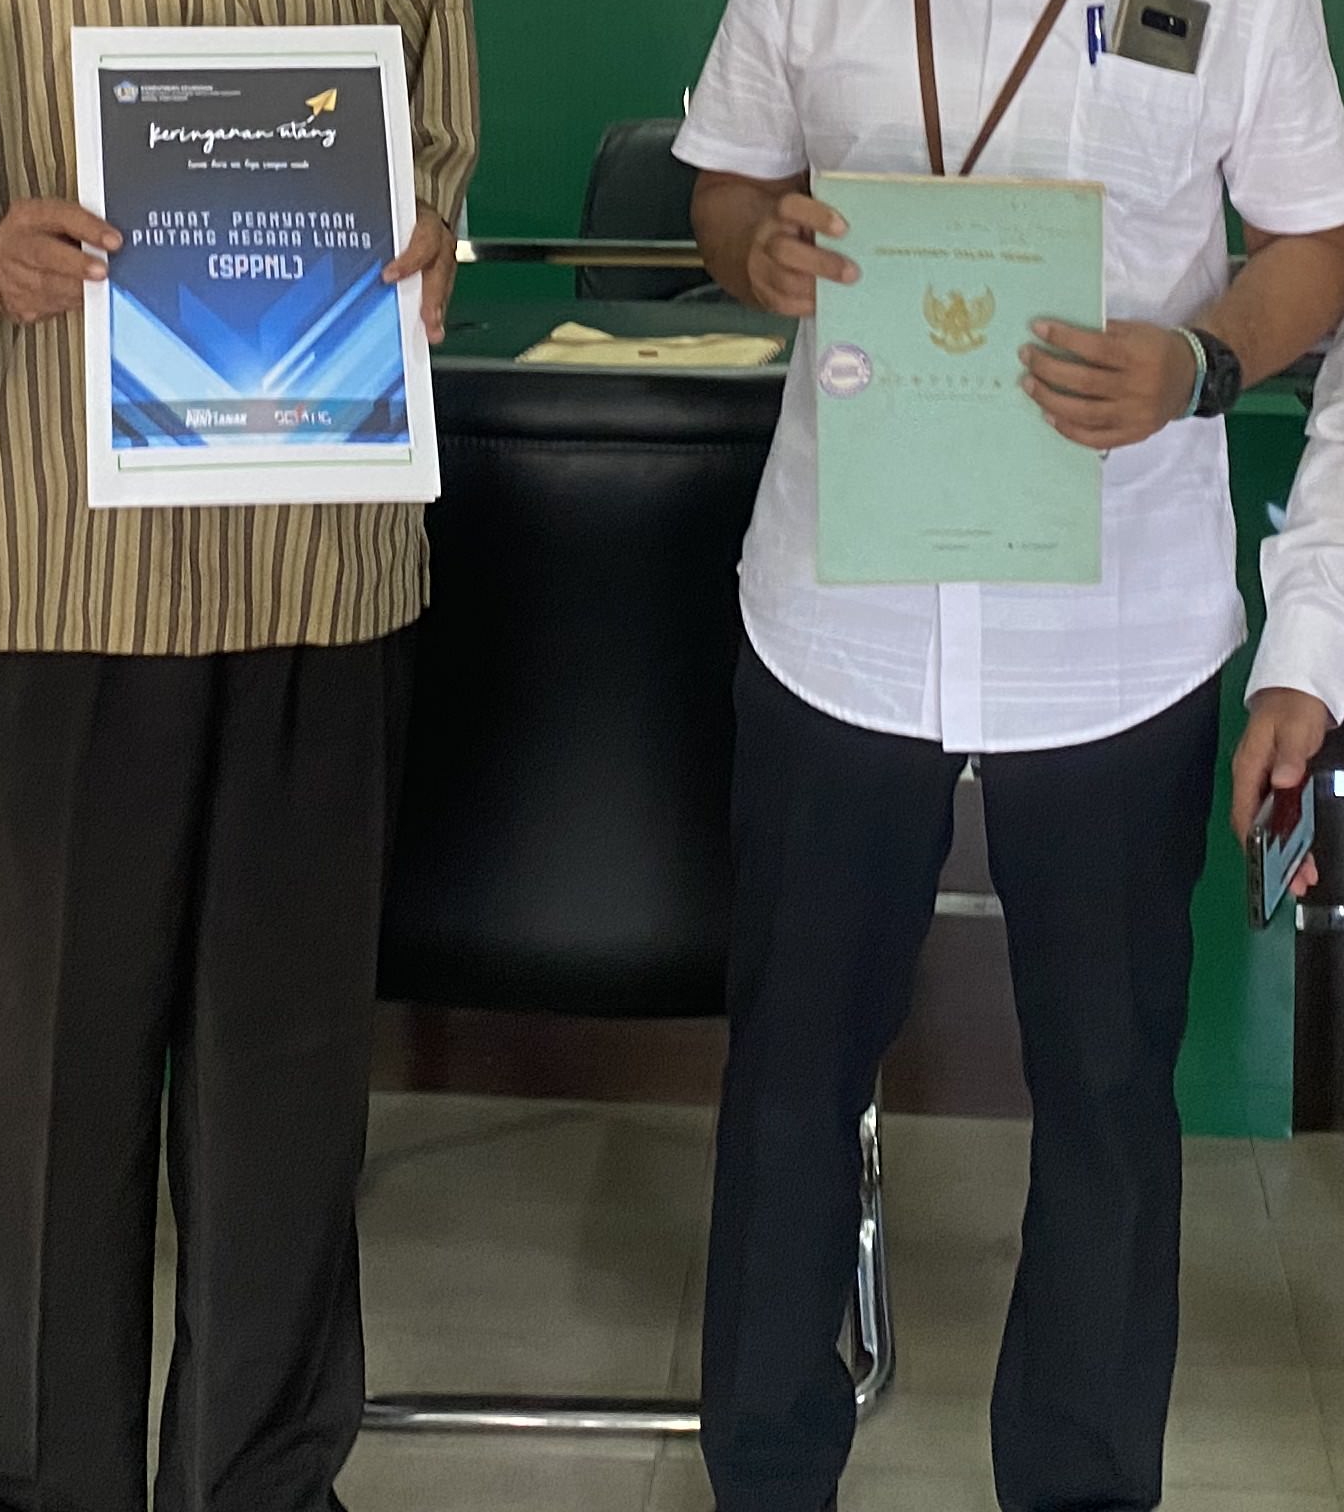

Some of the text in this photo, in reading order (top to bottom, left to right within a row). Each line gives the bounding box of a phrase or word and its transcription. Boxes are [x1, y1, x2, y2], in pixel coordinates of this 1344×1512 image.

[149, 122, 275, 154] keringanan
[147, 210, 356, 230] SURAT PERNYATAAN
[132, 229, 372, 250] PIUTANG NEGARA LUNAS
[208, 253, 304, 280] (SPPNL)
